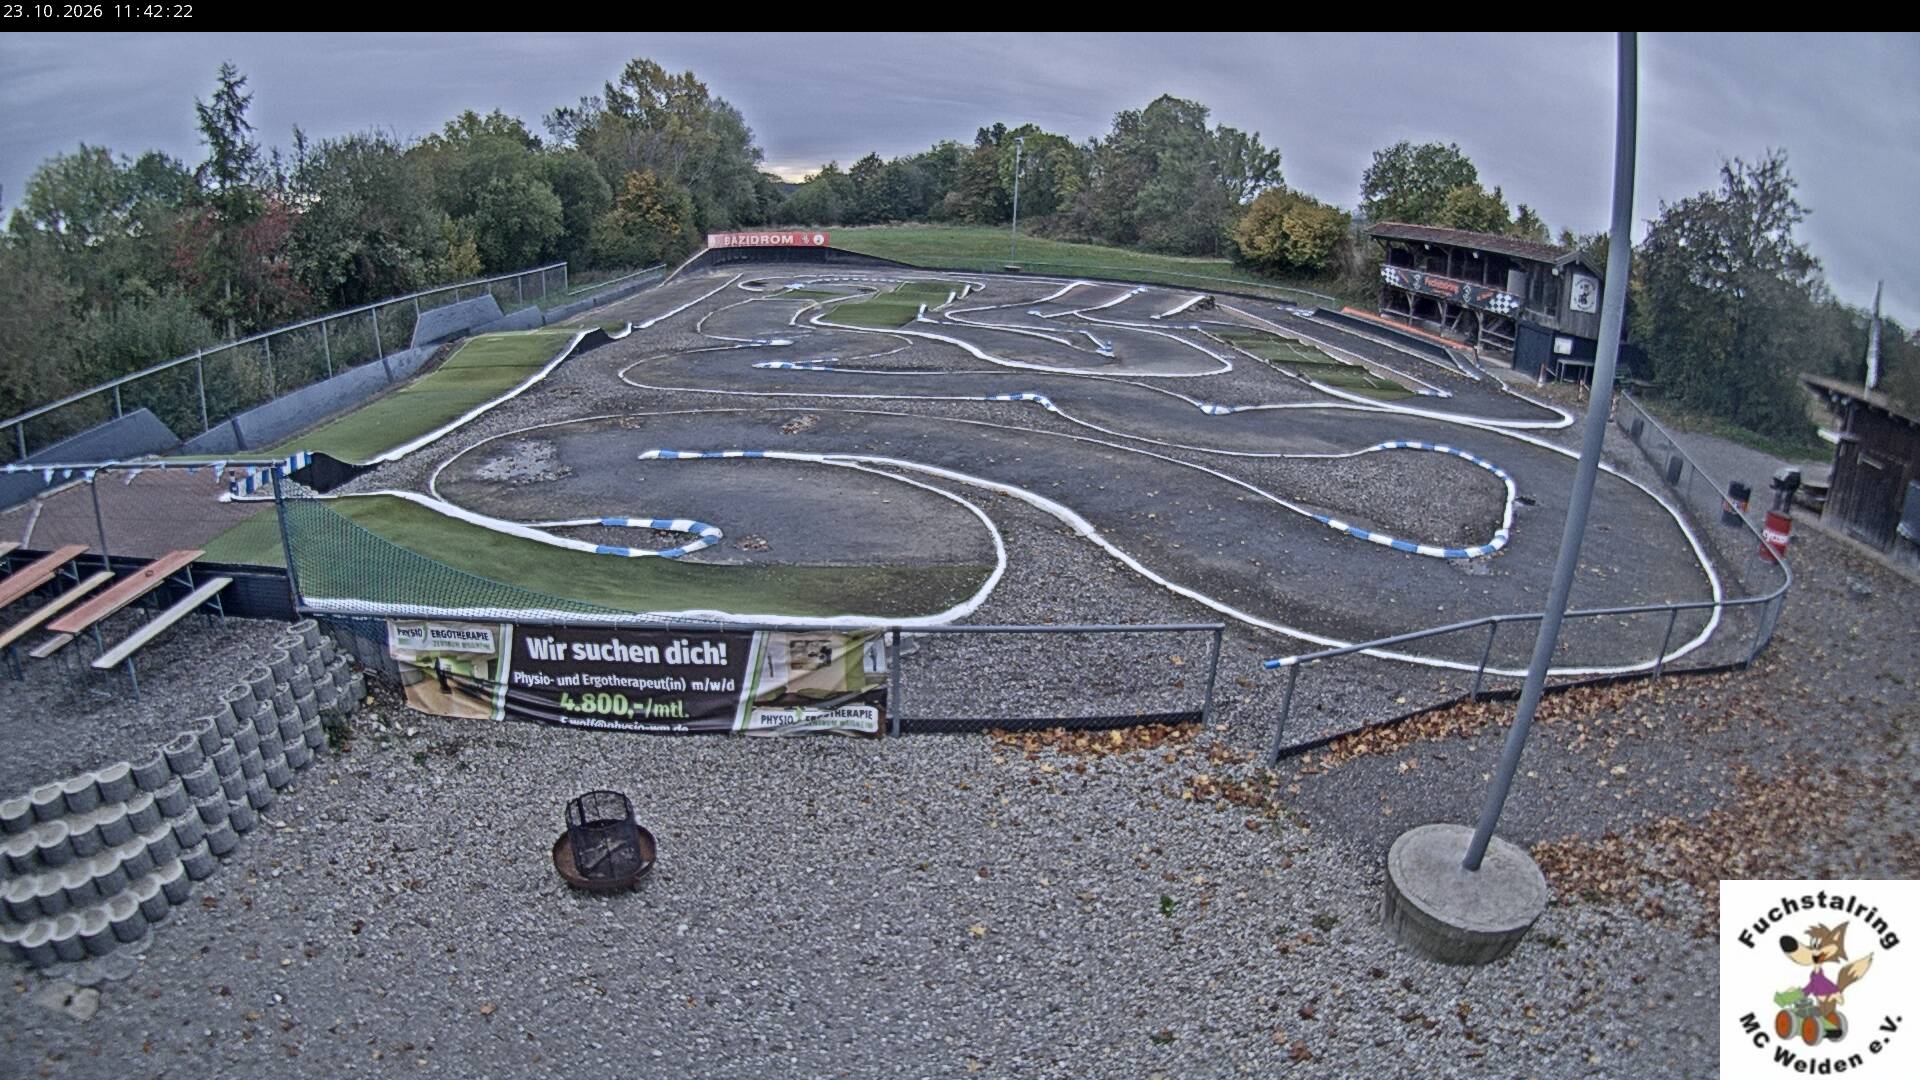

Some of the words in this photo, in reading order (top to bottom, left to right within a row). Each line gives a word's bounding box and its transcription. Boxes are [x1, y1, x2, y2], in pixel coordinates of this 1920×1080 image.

[724, 235, 794, 247] BAZIDROM
[430, 629, 490, 641] ERGOTHERAPIE
[526, 637, 567, 661] Wir
[572, 638, 660, 662] suchen
[665, 639, 728, 666] dich!
[514, 672, 555, 688] Physio-
[558, 673, 580, 686] und
[583, 673, 687, 690] Ergotherapeut(in)
[691, 678, 735, 691] m/w/d
[760, 714, 794, 726] PHYSIO
